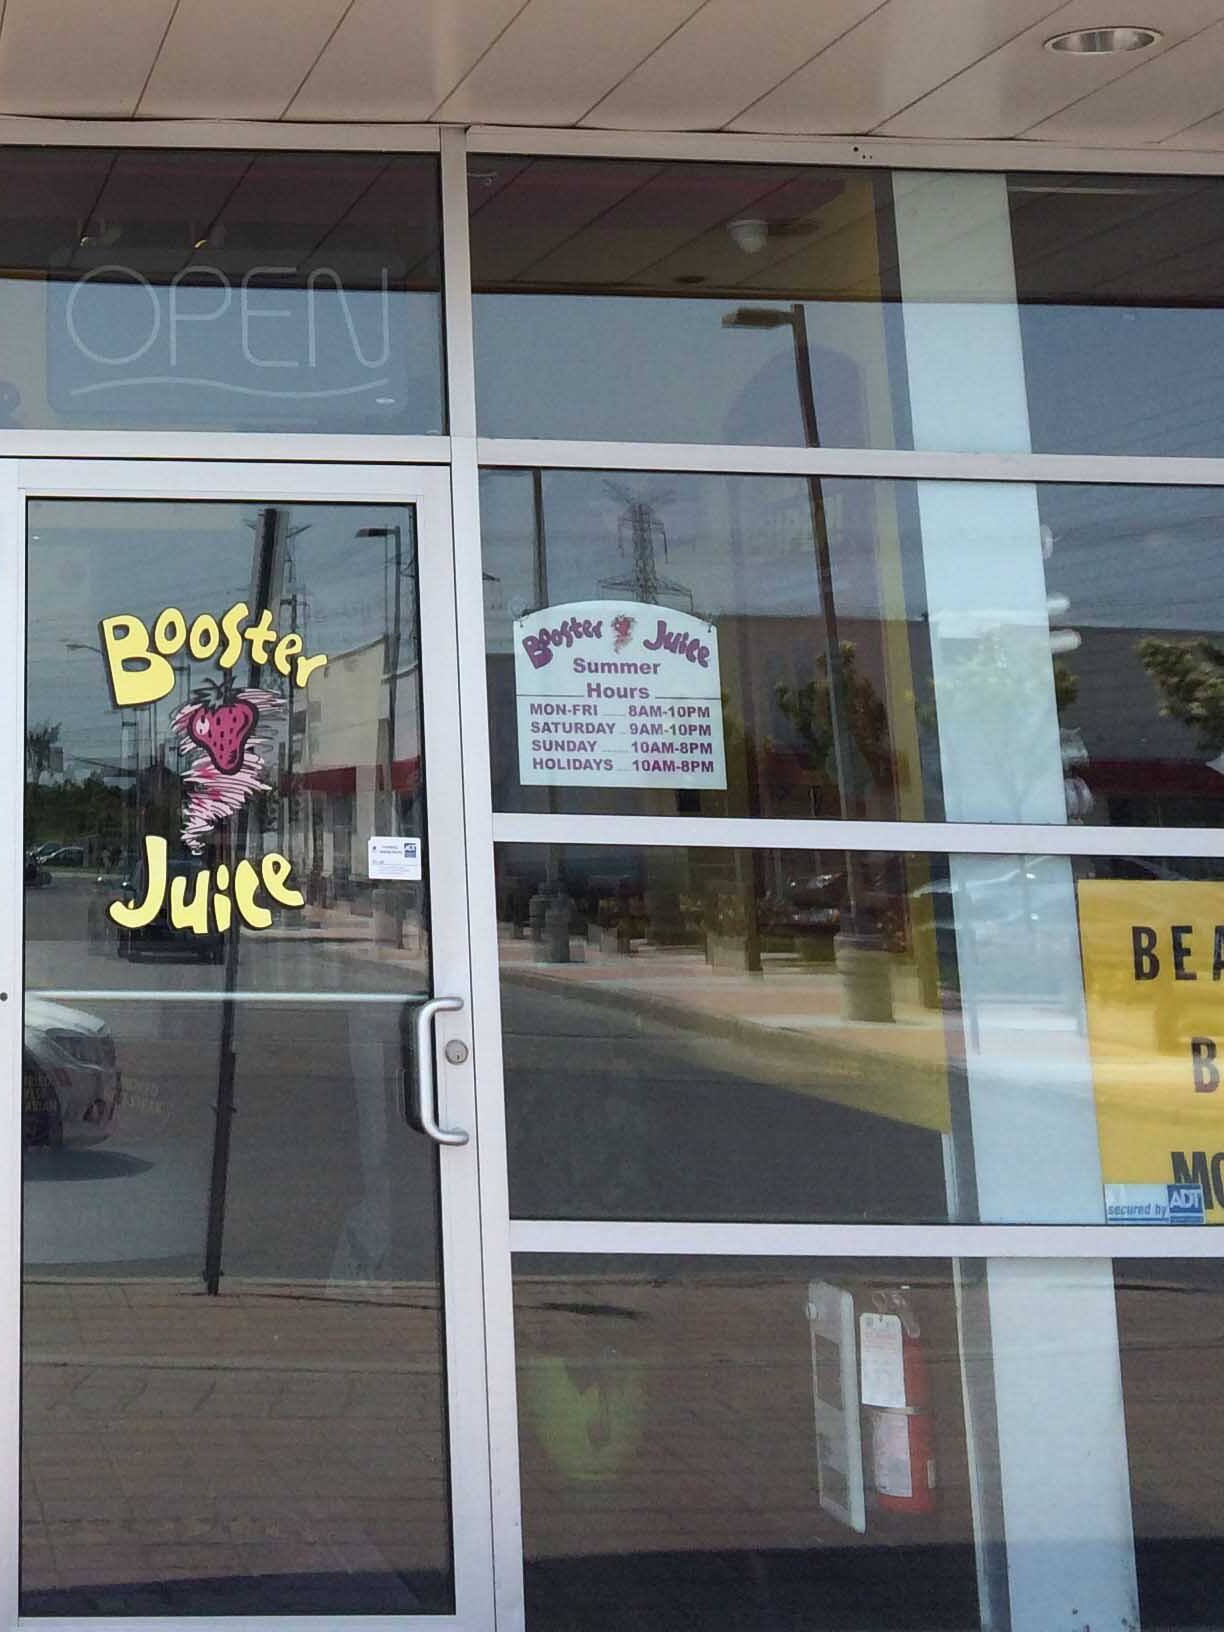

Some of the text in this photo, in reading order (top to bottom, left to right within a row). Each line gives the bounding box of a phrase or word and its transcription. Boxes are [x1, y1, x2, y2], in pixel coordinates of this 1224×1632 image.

[66, 264, 391, 368] OPEN
[522, 616, 711, 670] Booster Juice
[98, 602, 328, 706] Booster
[572, 657, 661, 675] Summer
[586, 681, 650, 700] Hours
[529, 702, 711, 719] MON-FRI 8AM-10PM
[530, 721, 712, 737] SATURDAY 9AM-10PM
[531, 739, 713, 755] SUNDAY 10AM-8PM
[532, 757, 715, 774] HOLIDAYS 10AM-8PM
[107, 834, 306, 935] Juice
[1170, 1188, 1202, 1210] ADT
